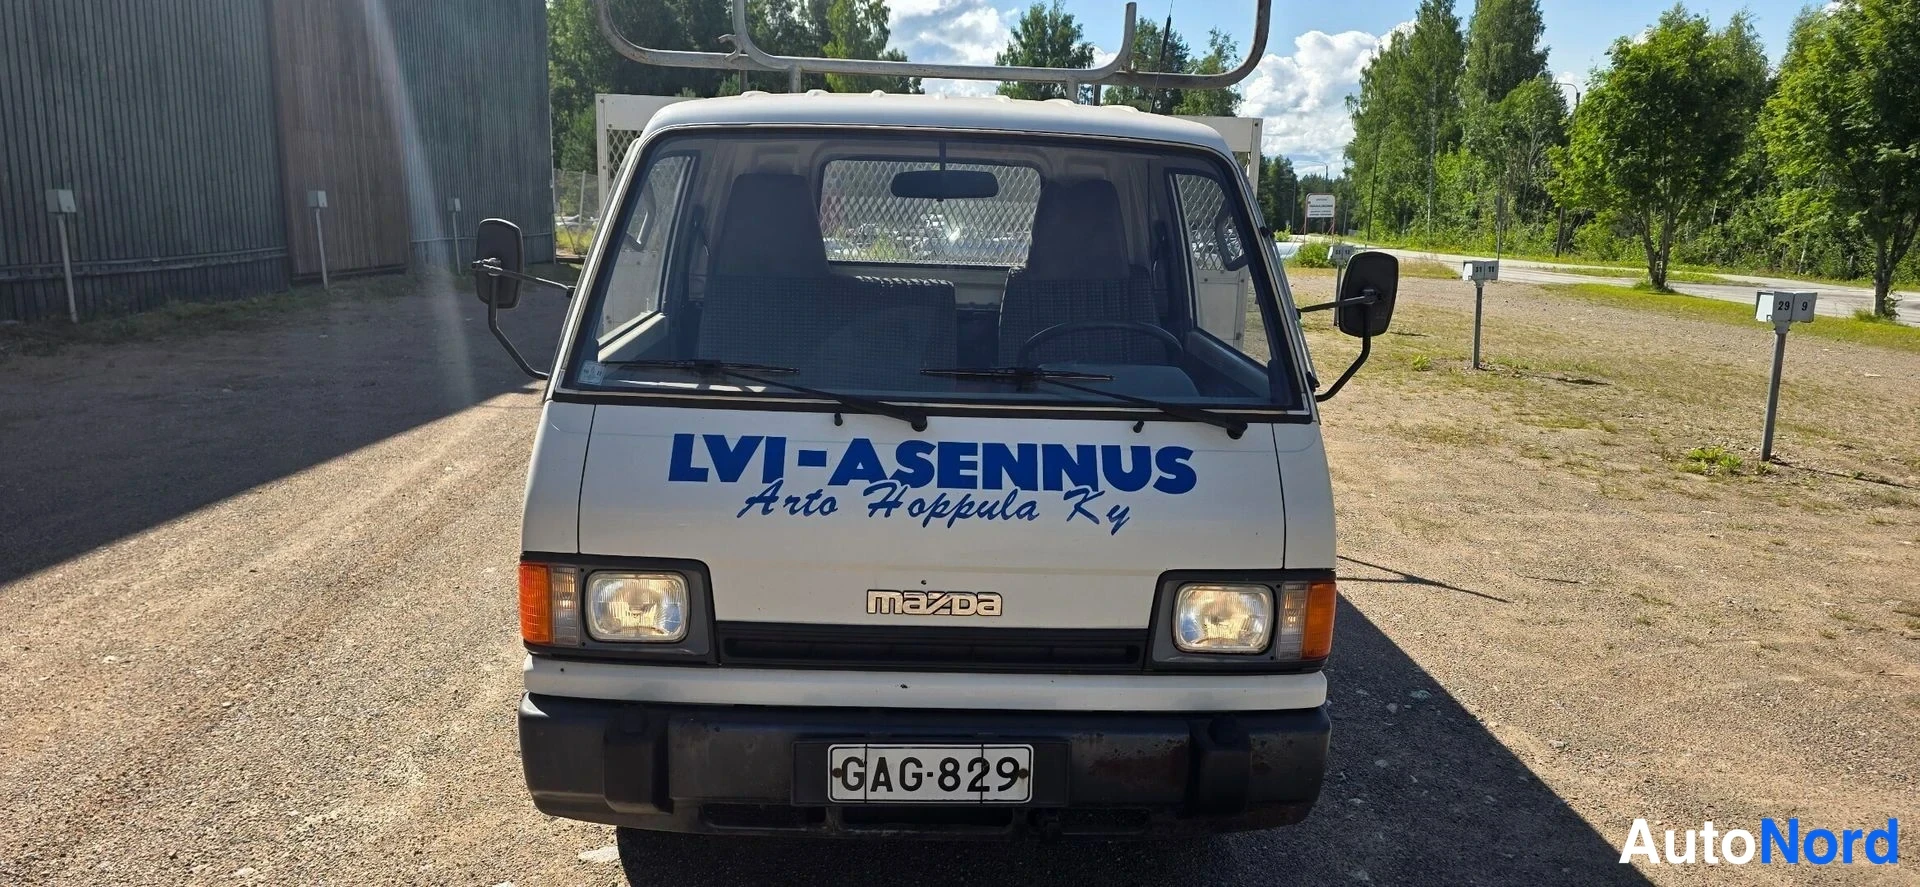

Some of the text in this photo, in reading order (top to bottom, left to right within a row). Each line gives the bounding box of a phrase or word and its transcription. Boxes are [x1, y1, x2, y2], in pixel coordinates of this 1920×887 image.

[1777, 300, 1790, 311] 29
[1801, 301, 1808, 312] 9
[668, 433, 1197, 494] LVI-ASENNUS
[737, 479, 1130, 535] Arto Hoppula Ky
[840, 756, 1021, 793] GAG-829
